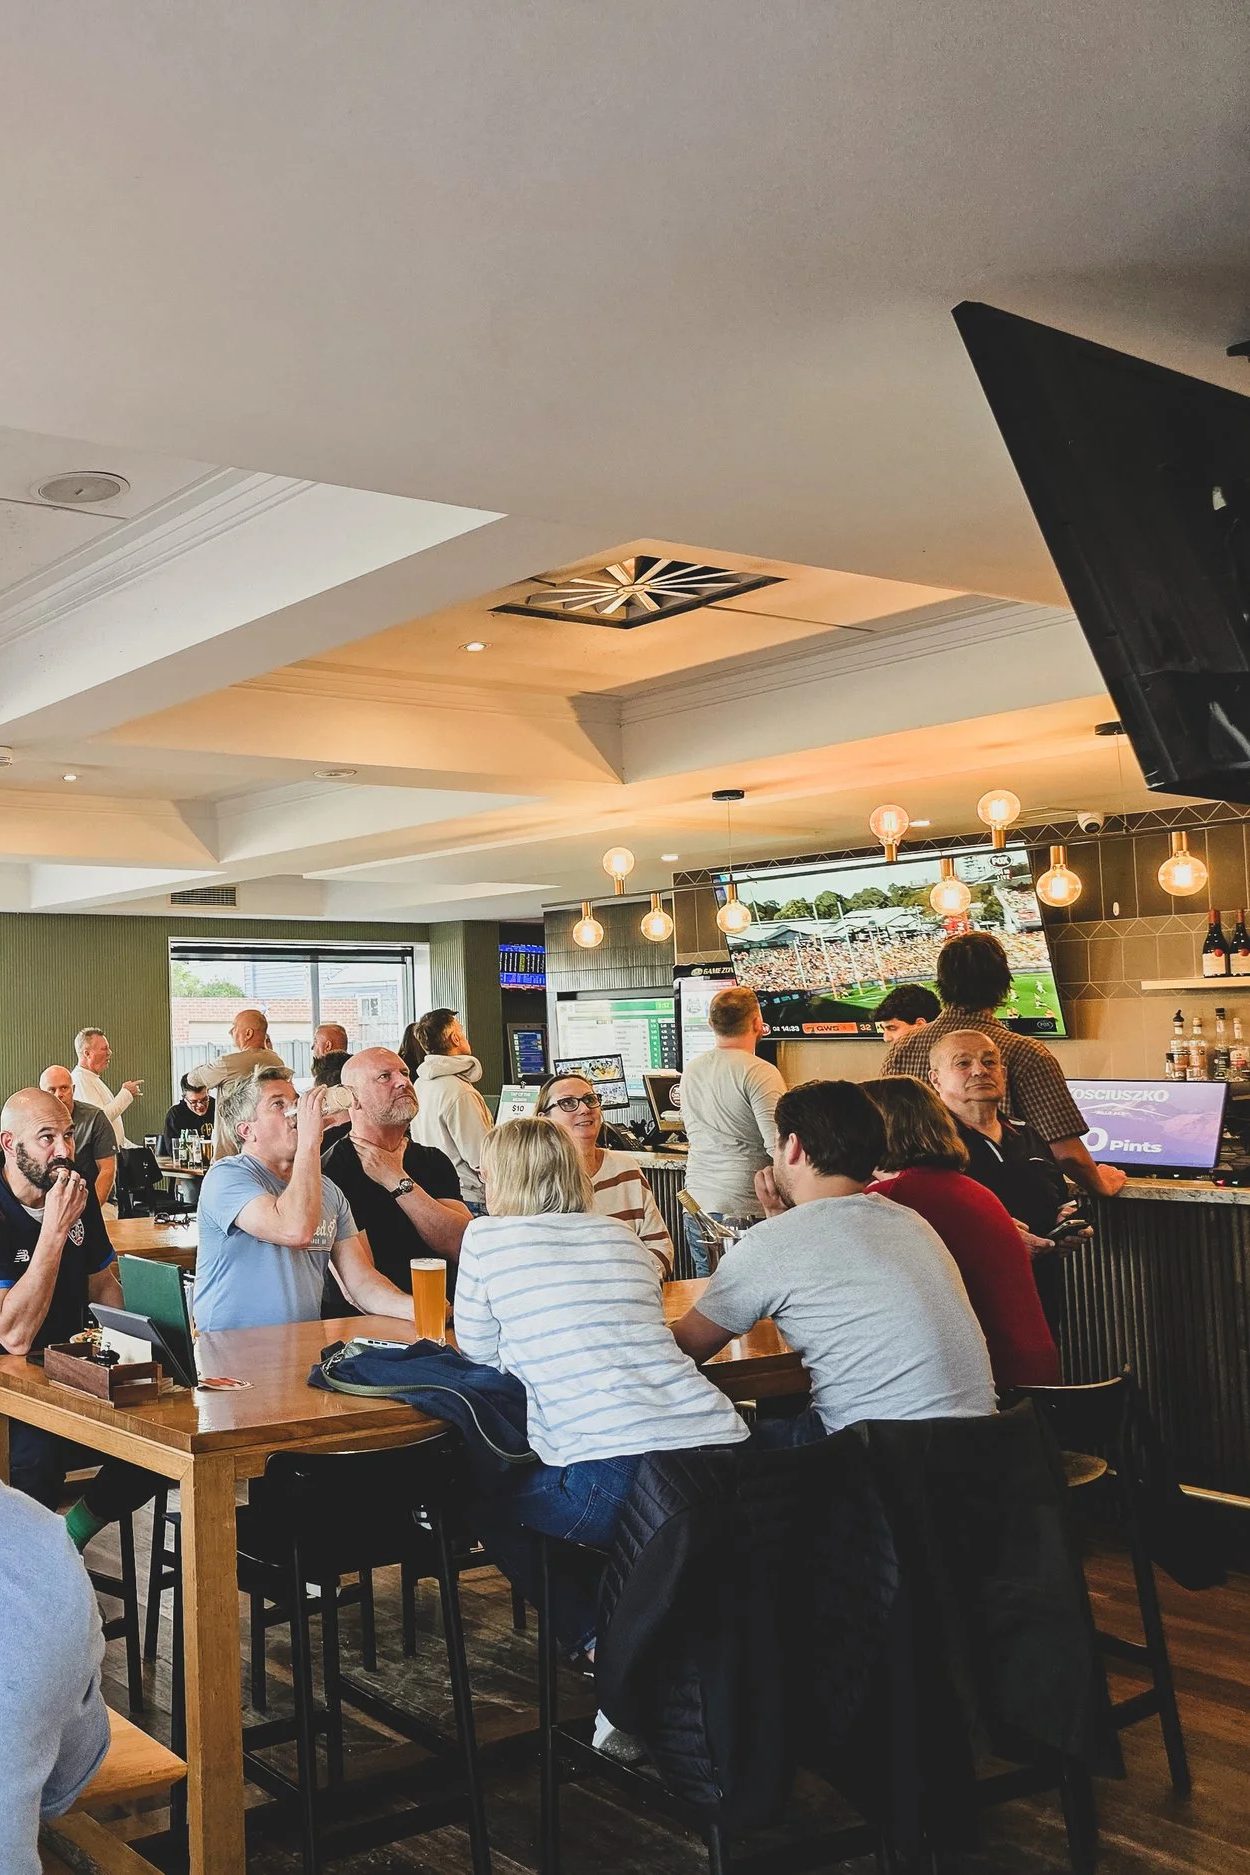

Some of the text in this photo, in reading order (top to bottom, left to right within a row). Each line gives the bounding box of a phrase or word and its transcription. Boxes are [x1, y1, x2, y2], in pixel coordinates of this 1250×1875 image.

[991, 857, 1010, 865] FOX
[816, 1024, 840, 1032] GWS
[511, 1104, 525, 1112] $10
[1110, 1139, 1162, 1153] Pints
